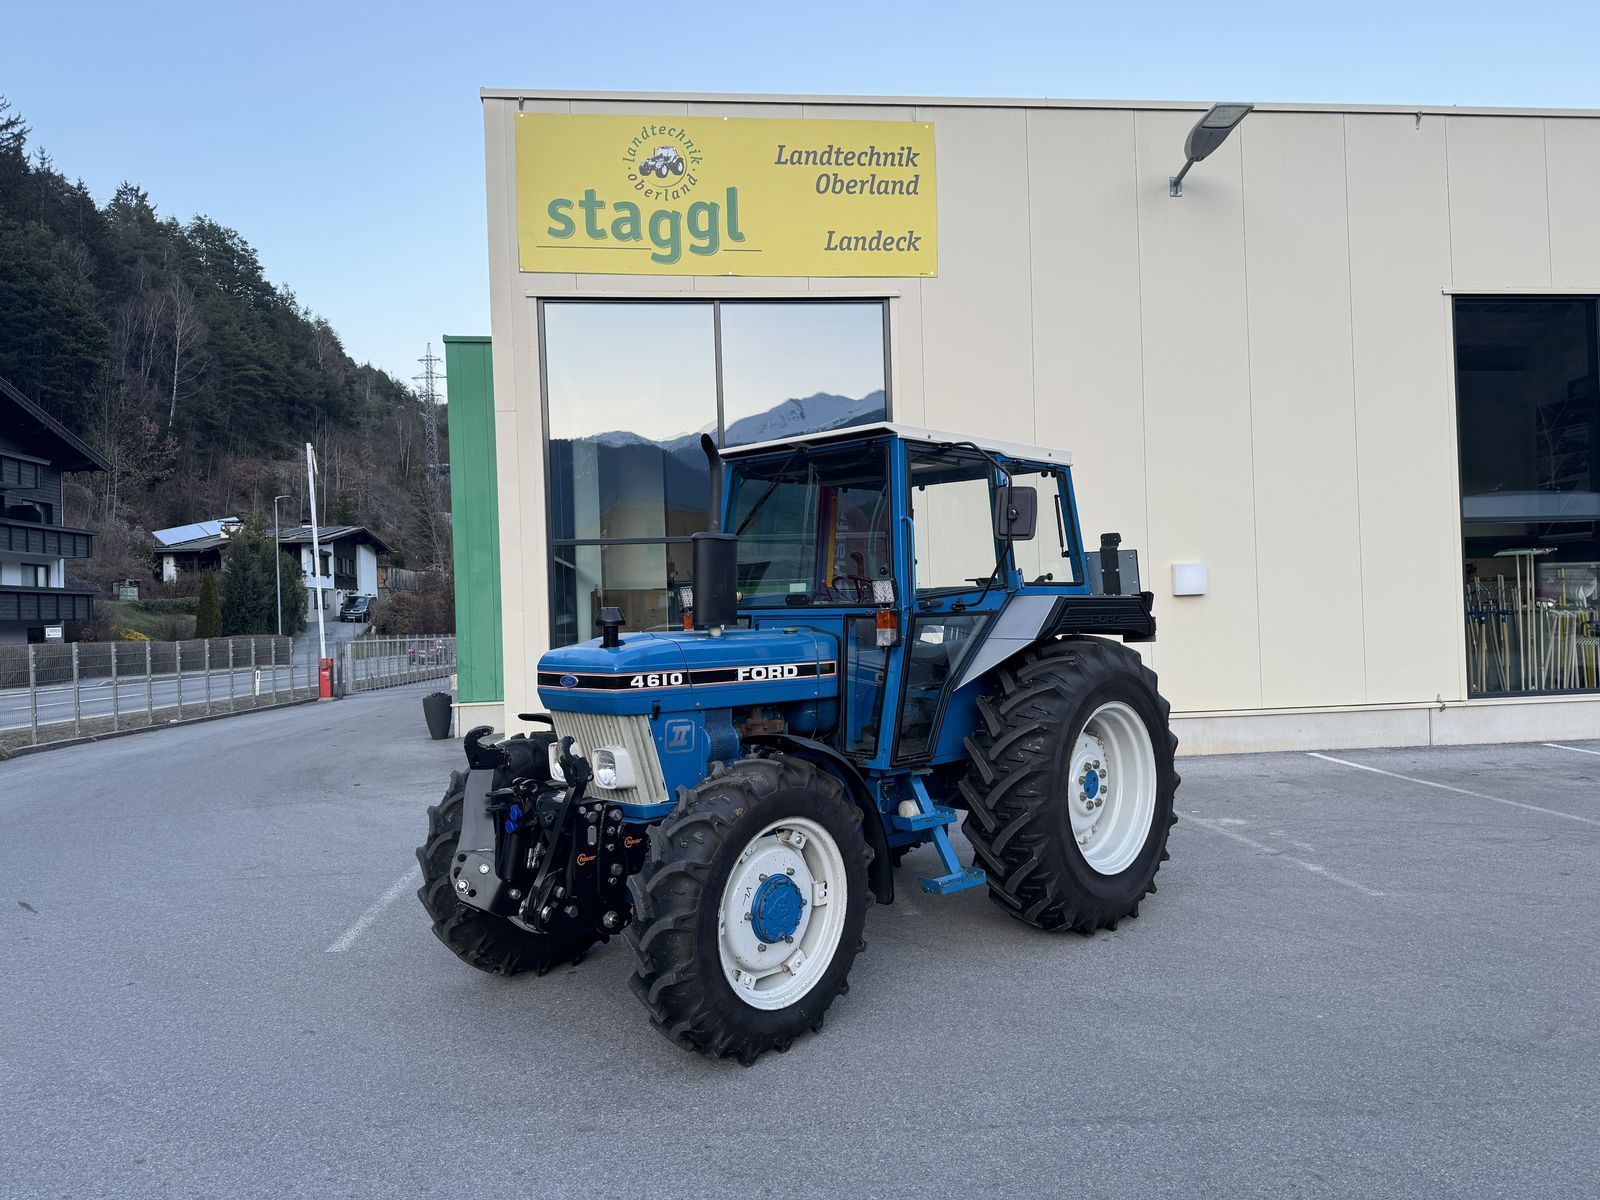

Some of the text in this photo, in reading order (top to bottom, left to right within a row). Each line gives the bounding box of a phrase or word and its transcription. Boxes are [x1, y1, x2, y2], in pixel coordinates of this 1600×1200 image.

[623, 124, 703, 165] landtechnik
[774, 145, 920, 168] Landtechnik
[627, 173, 698, 201] oberland
[815, 174, 920, 195] Oberland
[547, 186, 746, 264] staggl
[824, 231, 921, 252] Landeck
[630, 672, 683, 688] 4610
[737, 664, 799, 681] FORD
